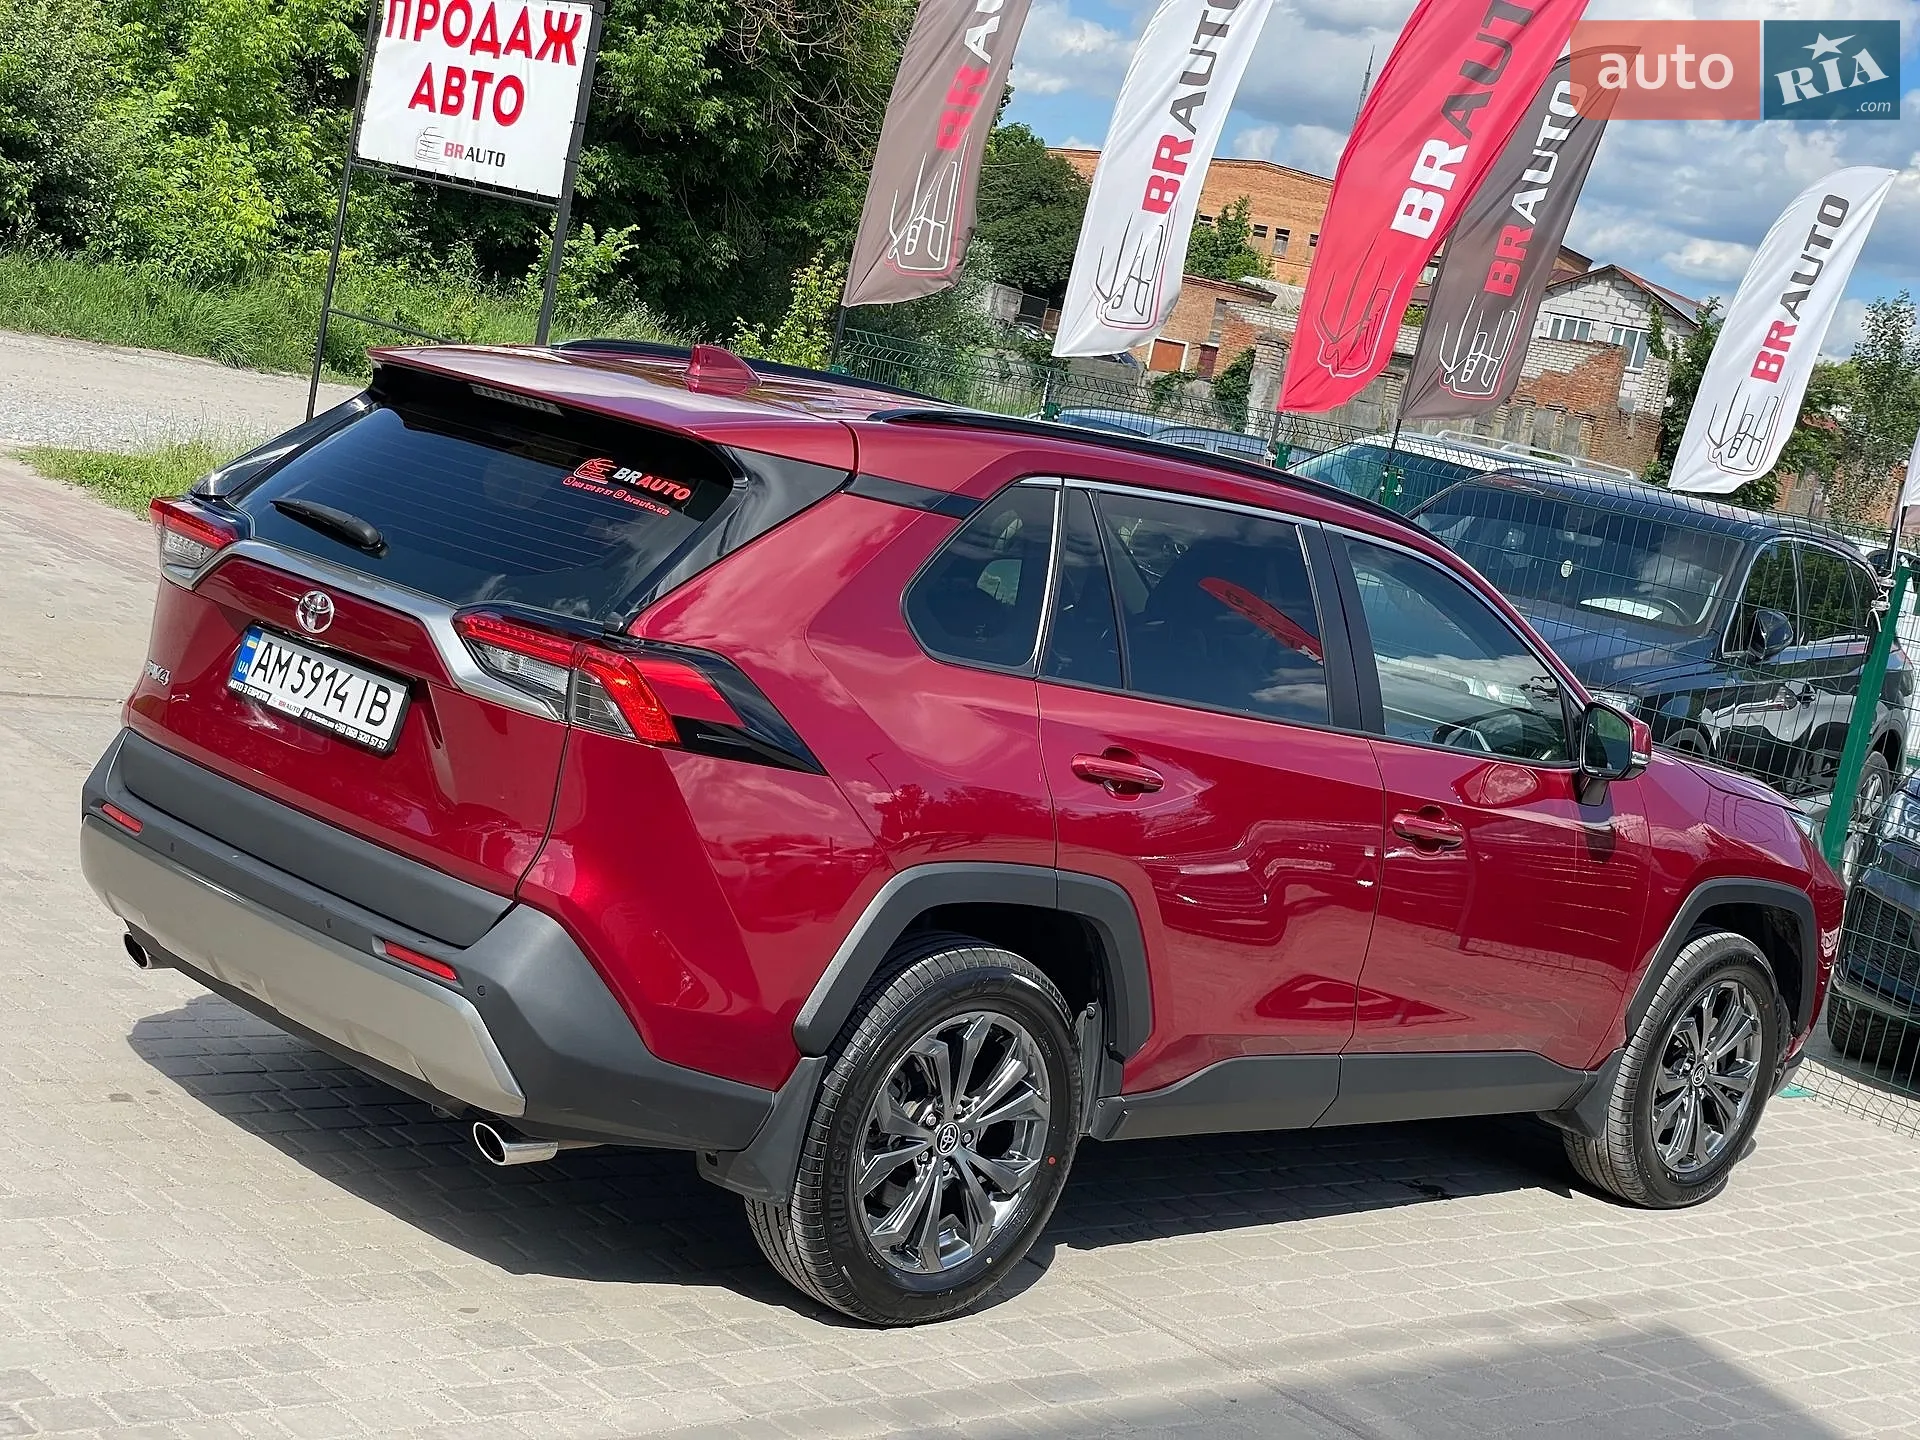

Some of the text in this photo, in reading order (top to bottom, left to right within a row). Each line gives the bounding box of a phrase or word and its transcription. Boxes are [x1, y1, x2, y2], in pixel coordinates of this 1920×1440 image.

[385, 0, 583, 67] ПРОДАЖ
[407, 62, 525, 127] АВТО
[1141, 0, 1240, 216] BRAUT
[443, 141, 506, 168] BRAUTO
[1483, 79, 1588, 297] BRAUTO
[1749, 193, 1850, 384] BRAUTO
[612, 467, 692, 501] BRAUTO
[623, 494, 671, 517] brauto.ua
[237, 661, 249, 675] UA
